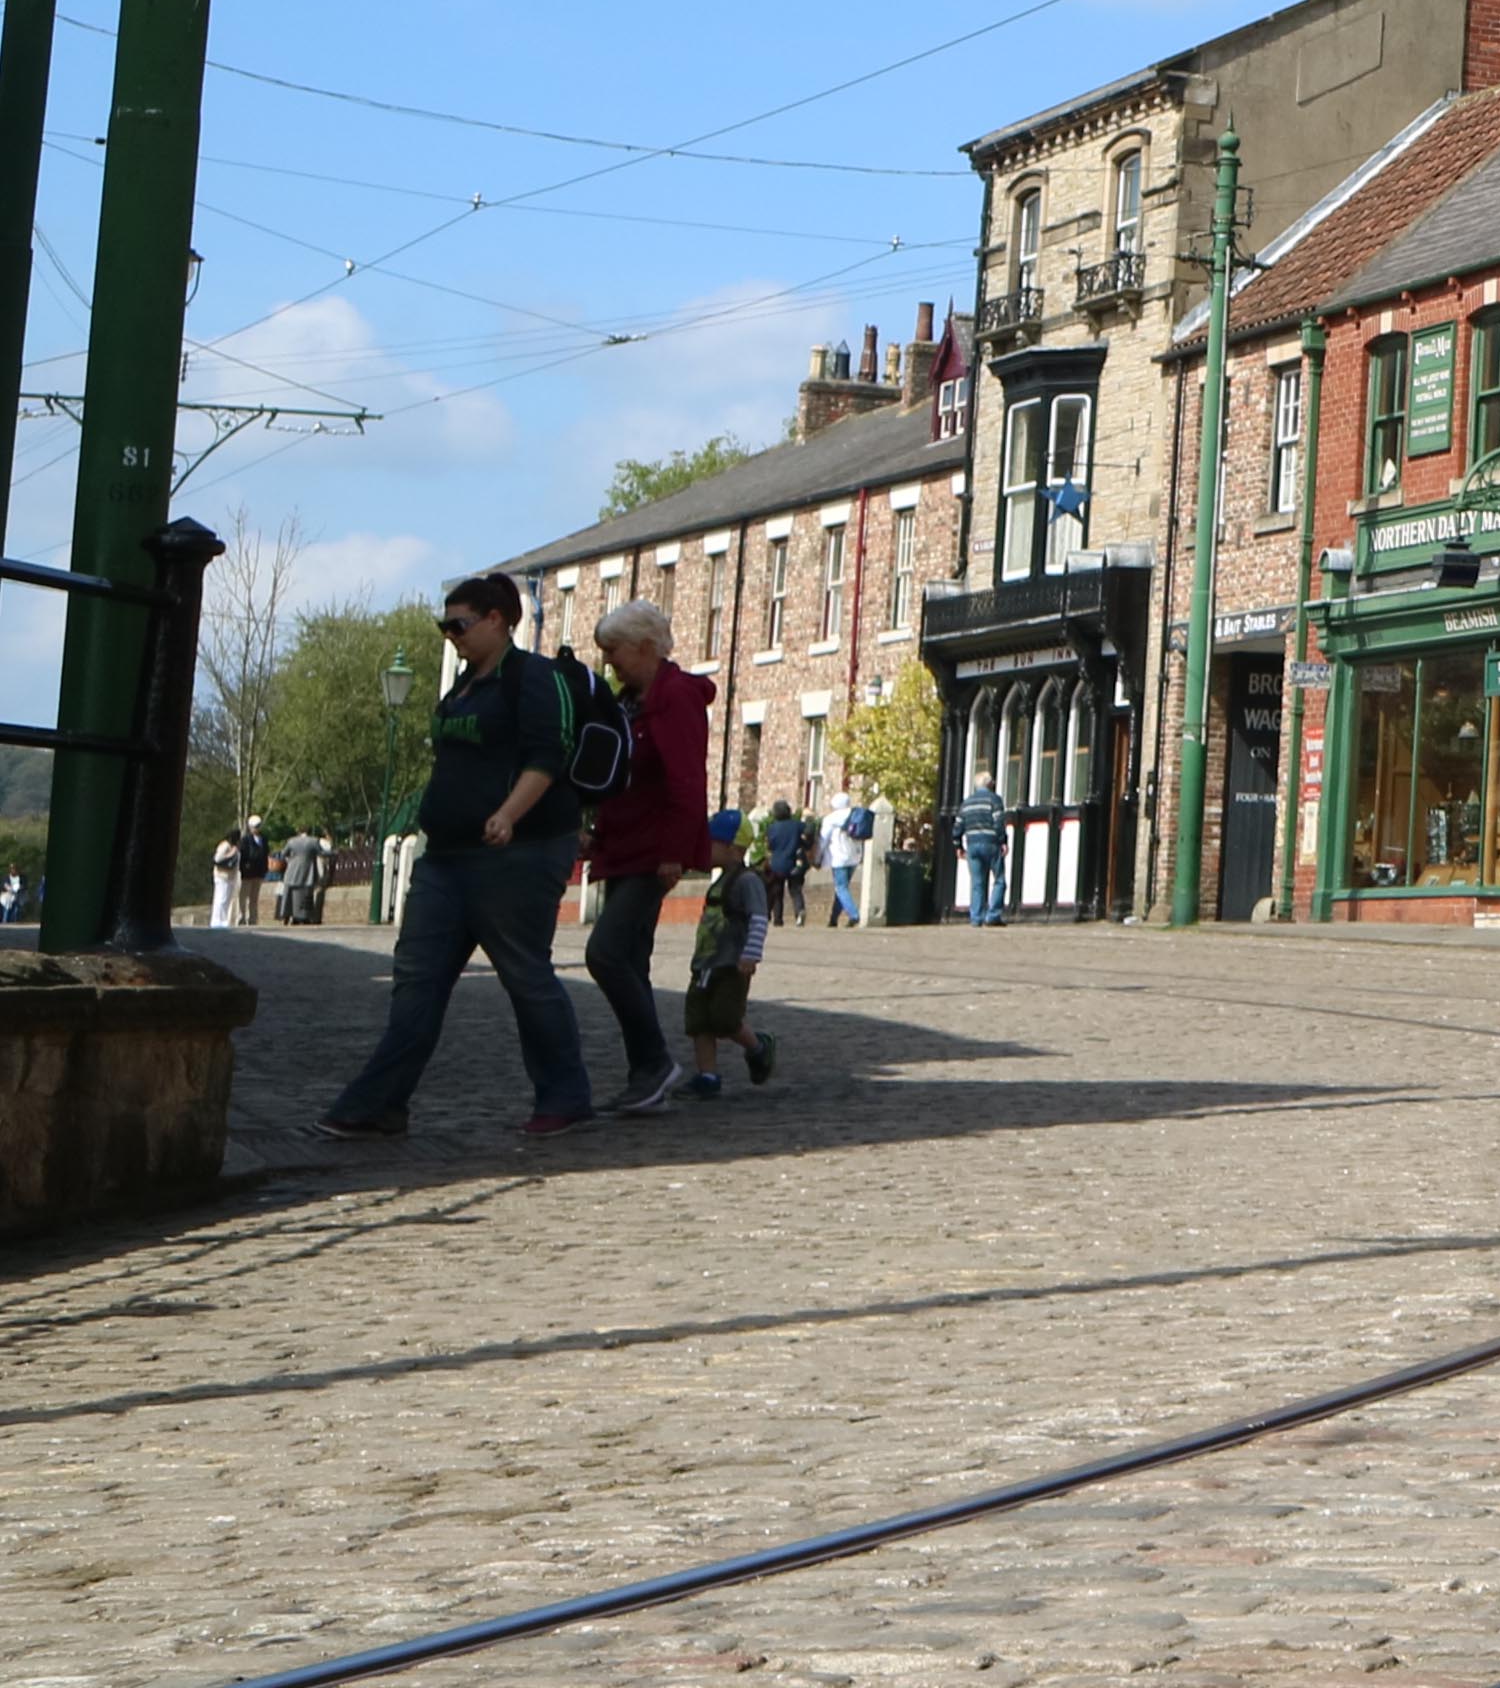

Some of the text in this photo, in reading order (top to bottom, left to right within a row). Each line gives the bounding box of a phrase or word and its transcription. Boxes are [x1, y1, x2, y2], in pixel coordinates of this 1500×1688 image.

[1371, 518, 1435, 552] NORTHERN
[1244, 613, 1276, 633] STABLES
[1444, 608, 1497, 632] BEAMISH
[977, 647, 1072, 673] THE SUN INN
